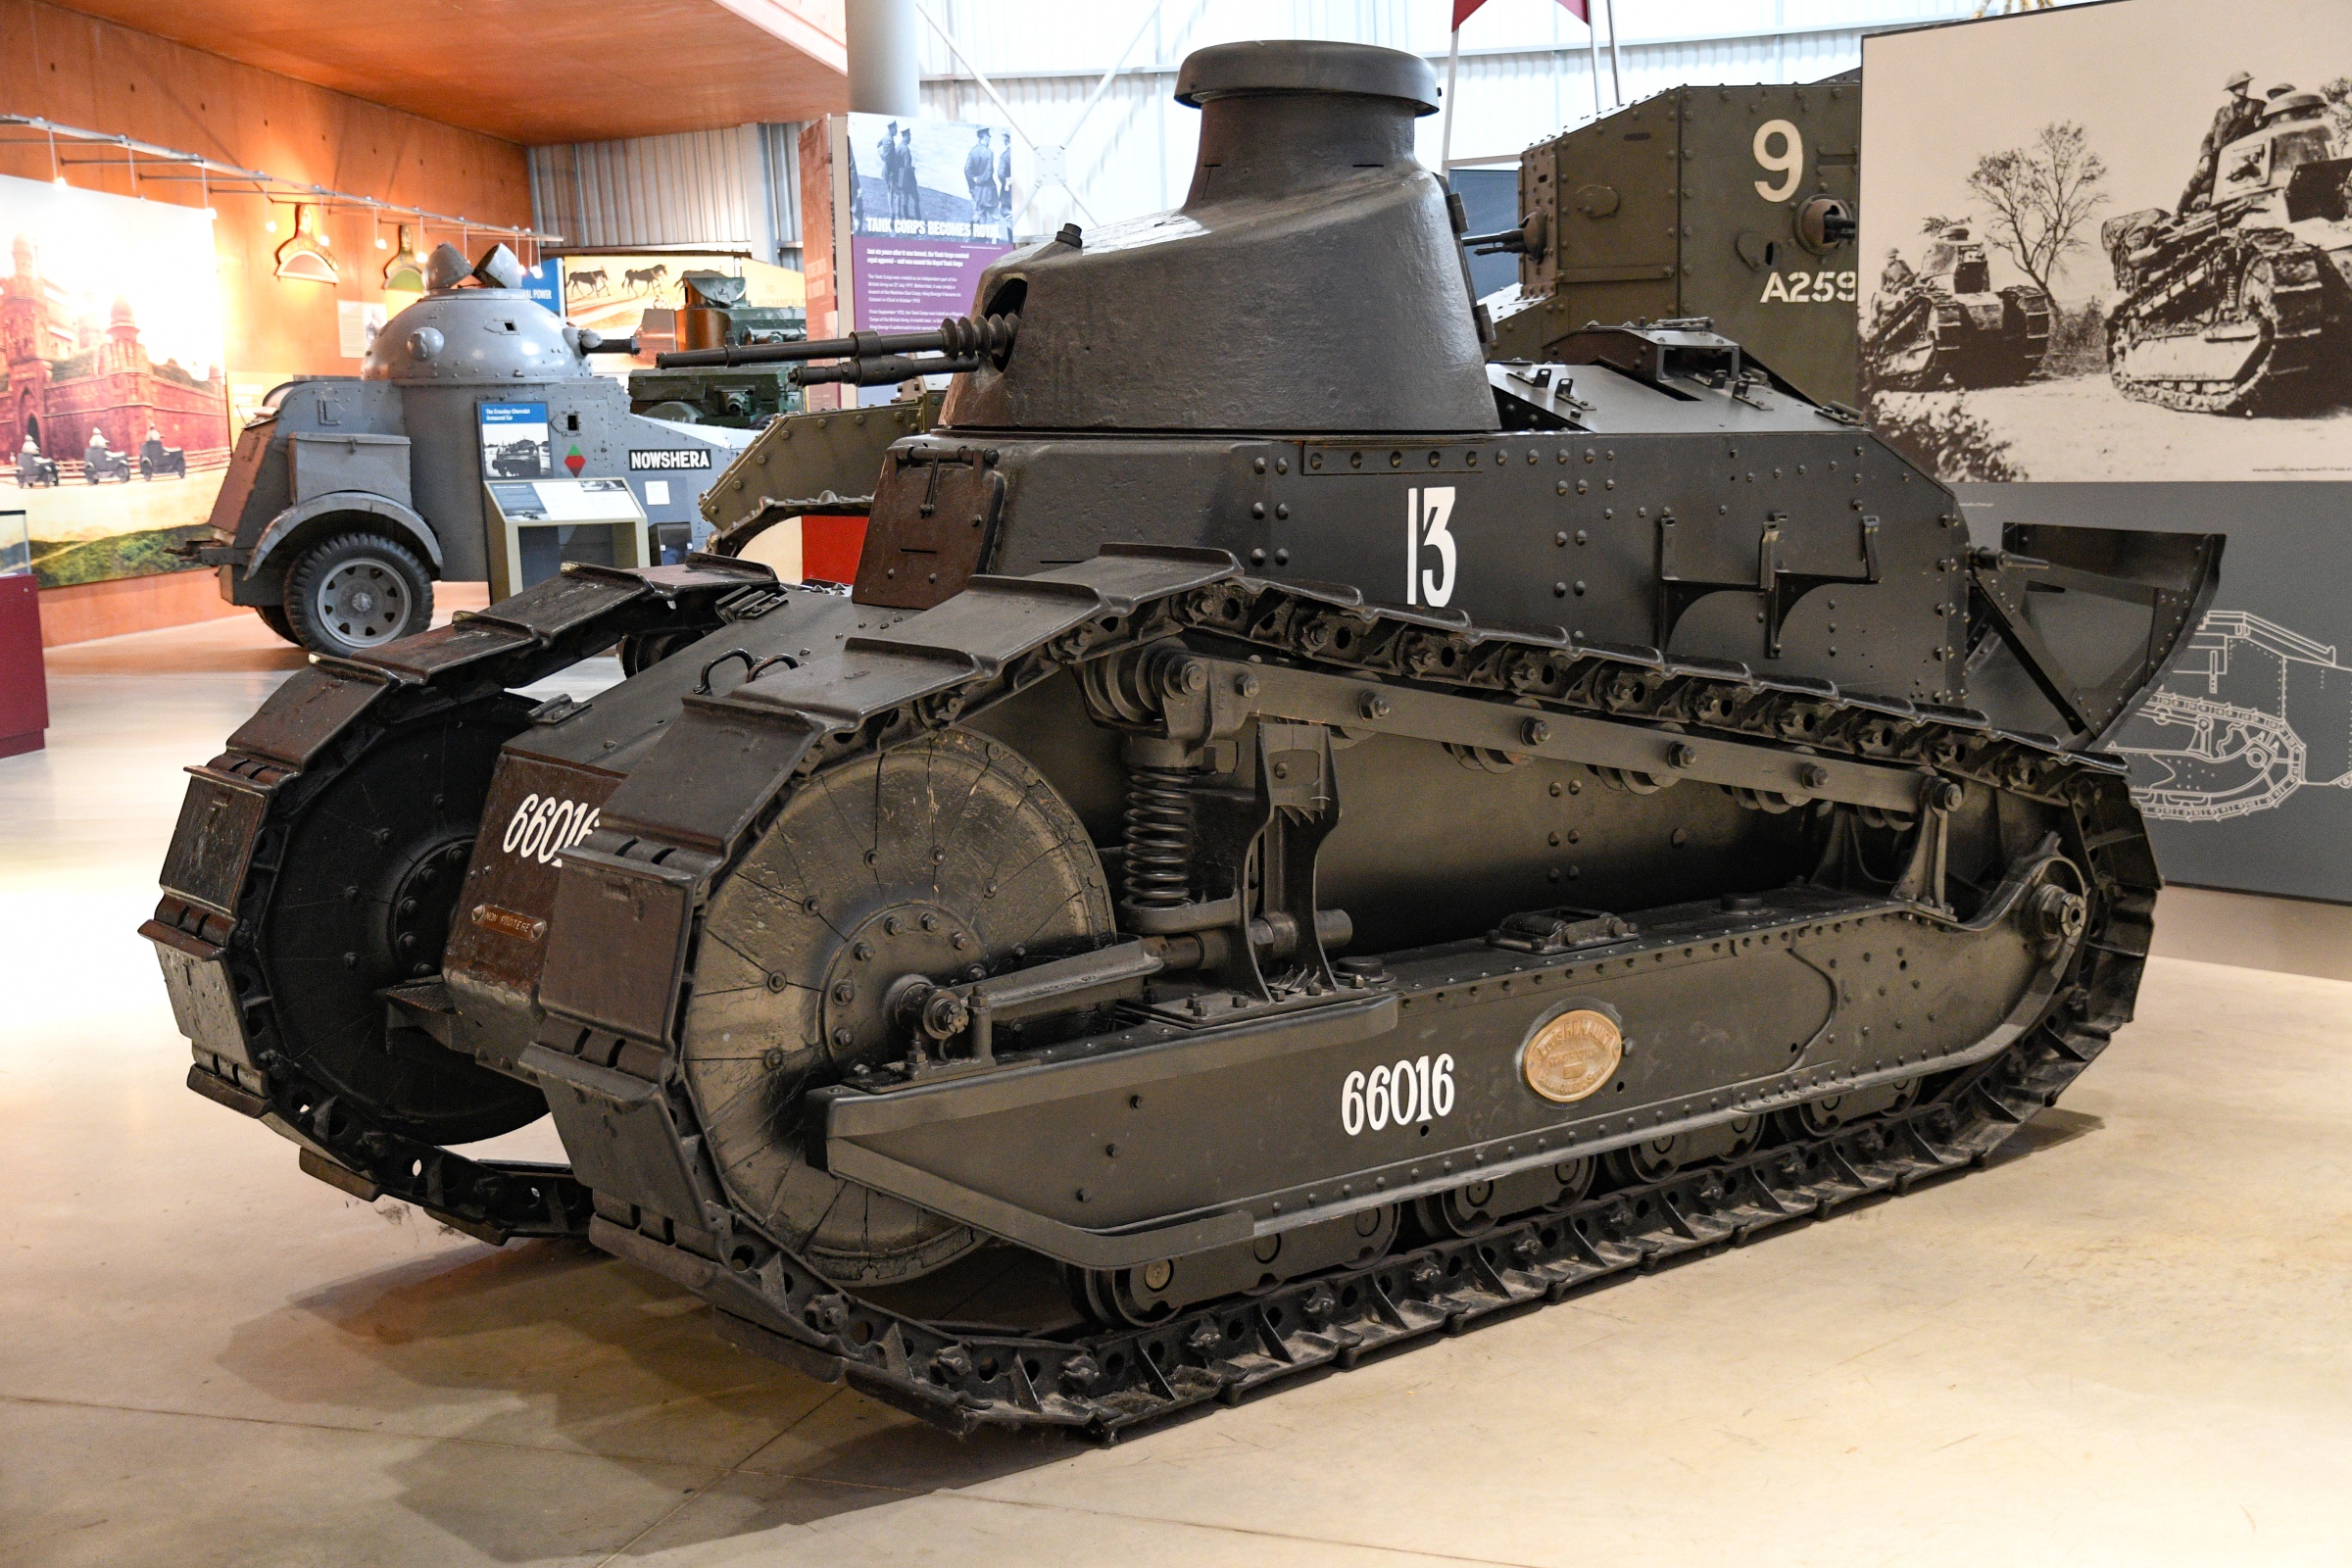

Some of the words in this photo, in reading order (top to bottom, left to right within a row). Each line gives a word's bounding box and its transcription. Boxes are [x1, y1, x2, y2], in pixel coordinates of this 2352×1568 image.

[1752, 119, 1804, 203] 9
[865, 217, 893, 233] TANK
[894, 219, 926, 235] CORPS
[927, 220, 972, 237] BECOMES
[972, 223, 1002, 239] ROYAL
[534, 289, 552, 300] POWER
[1759, 270, 1856, 303] A259
[631, 450, 710, 469] NOWSHERA
[1406, 486, 1456, 608] 13
[1341, 1053, 1455, 1136] 66016
